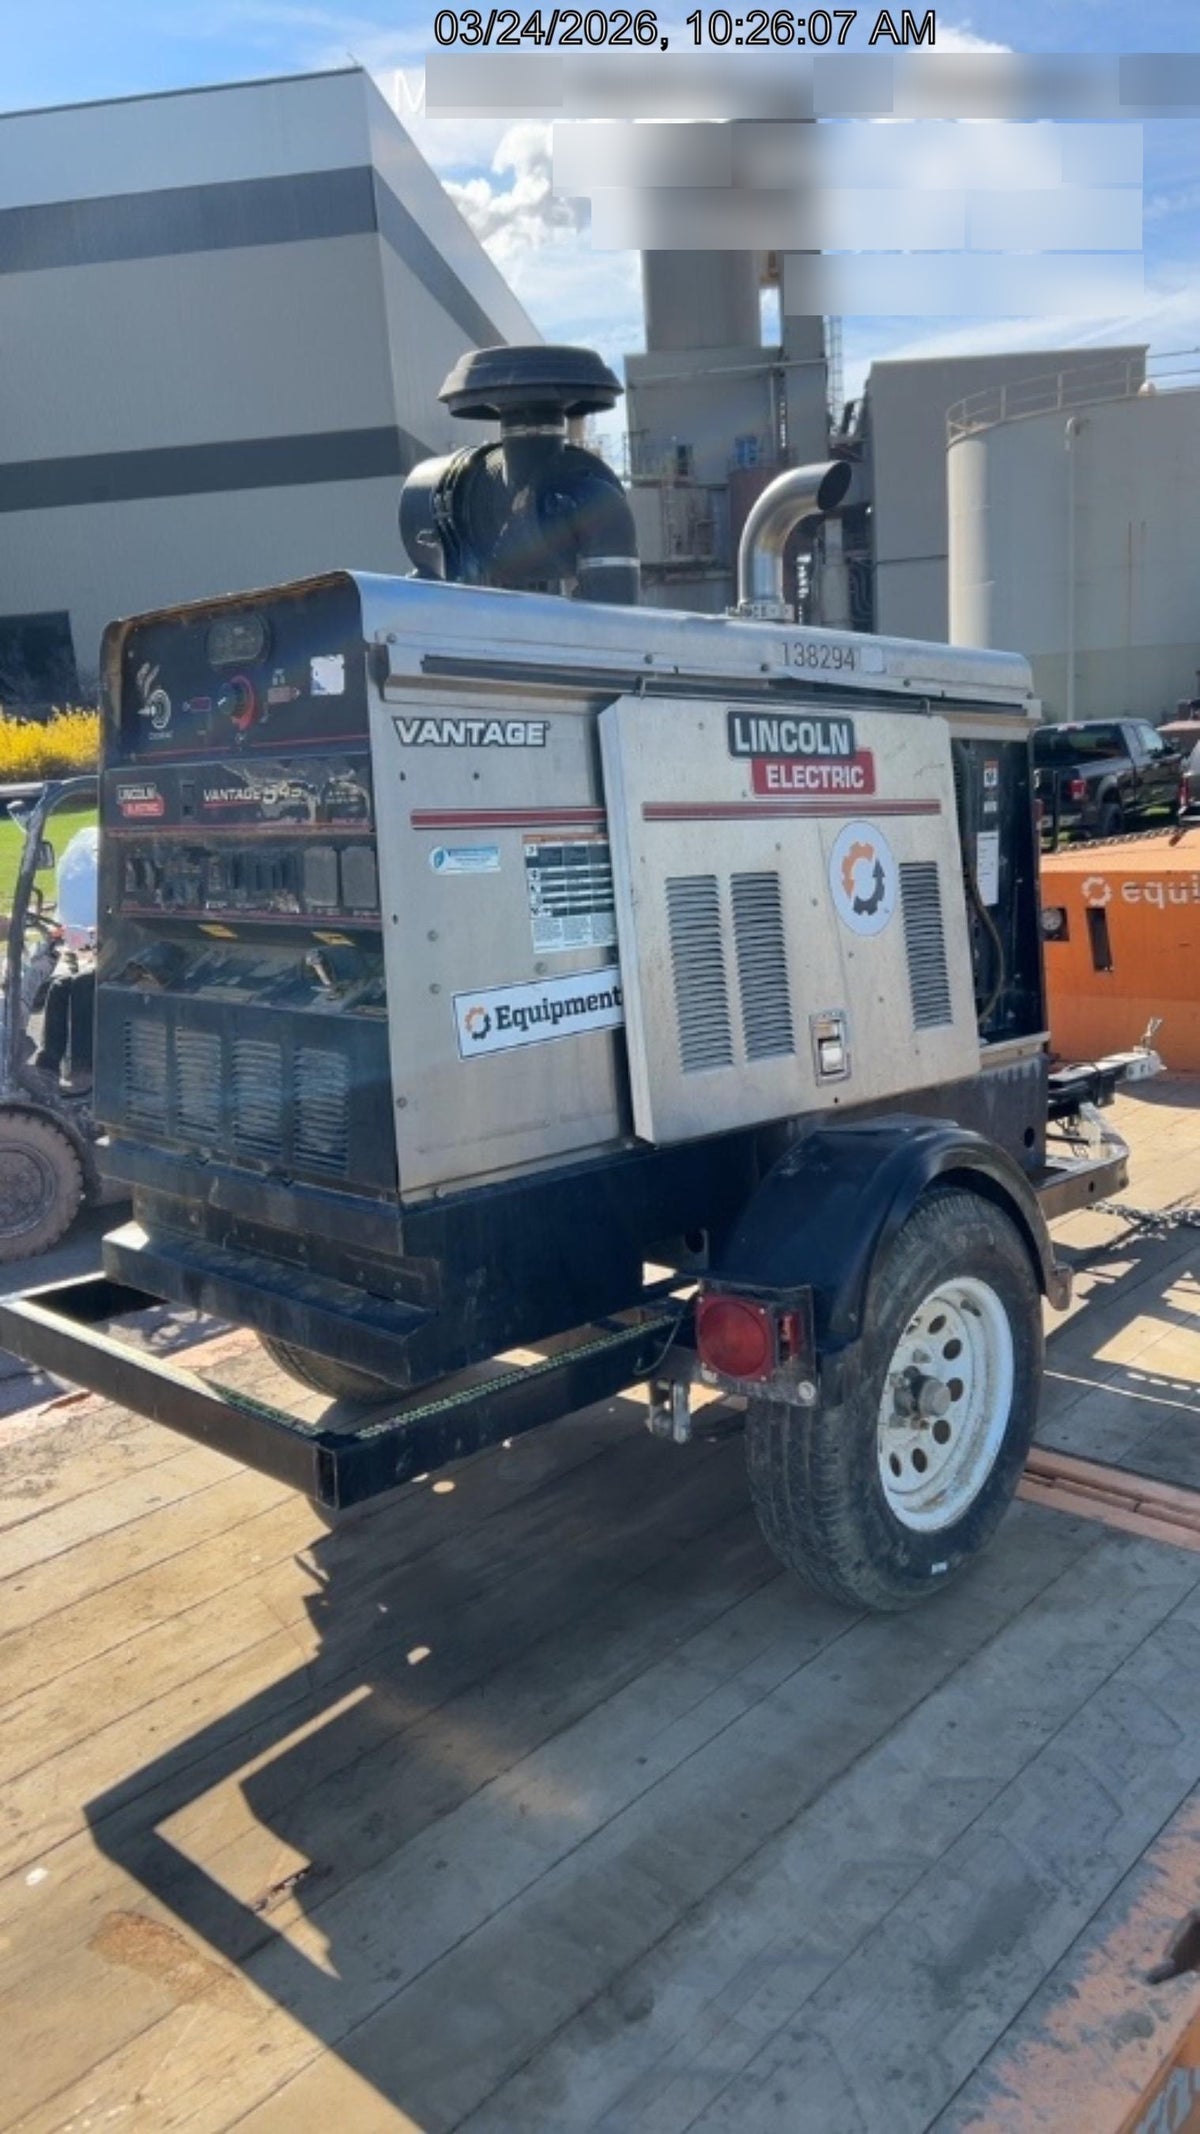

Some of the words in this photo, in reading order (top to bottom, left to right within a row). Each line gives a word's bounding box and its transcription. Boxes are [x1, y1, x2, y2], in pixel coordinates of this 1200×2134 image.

[783, 642, 856, 670] 138294
[393, 717, 548, 747] VANTAGE
[734, 718, 850, 754] LINCOLN
[766, 765, 864, 788] ELECTRIC
[495, 986, 623, 1031] Equipment
